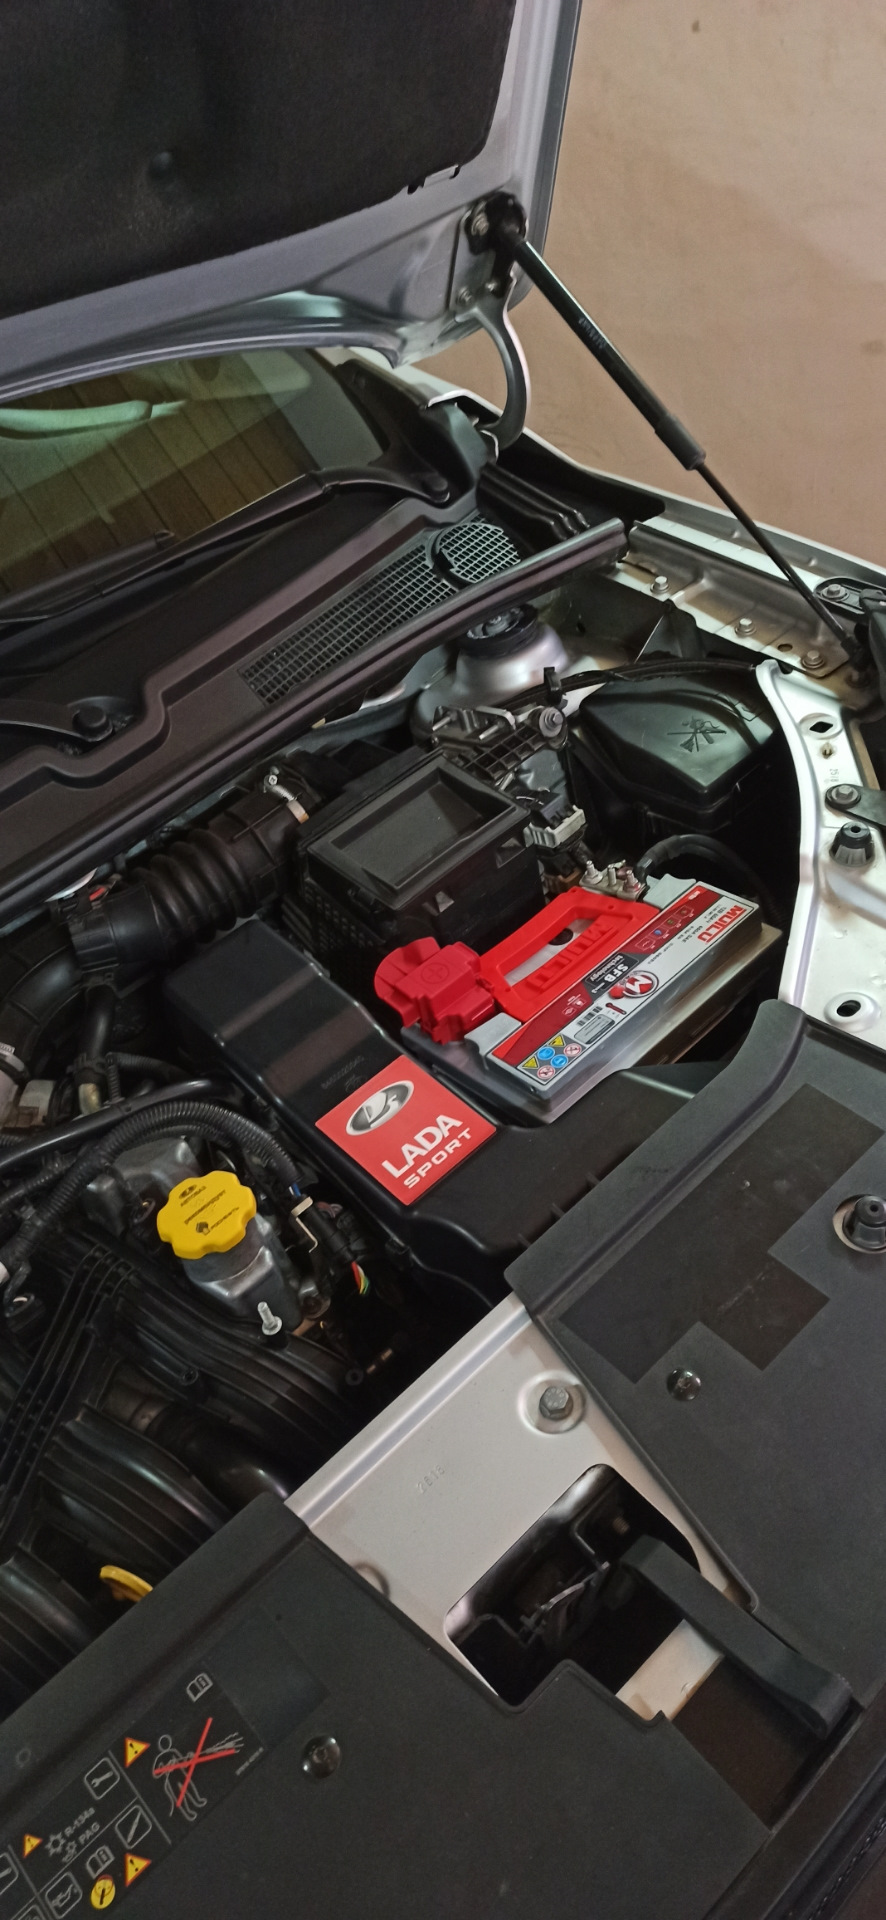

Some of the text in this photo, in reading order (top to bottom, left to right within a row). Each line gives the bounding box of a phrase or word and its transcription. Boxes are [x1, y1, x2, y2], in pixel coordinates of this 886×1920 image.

[590, 955, 624, 983] technology
[604, 965, 629, 989] SFB
[381, 1114, 464, 1179] LADA
[403, 1127, 472, 1190] SPORT
[78, 1821, 101, 1845] PAG
